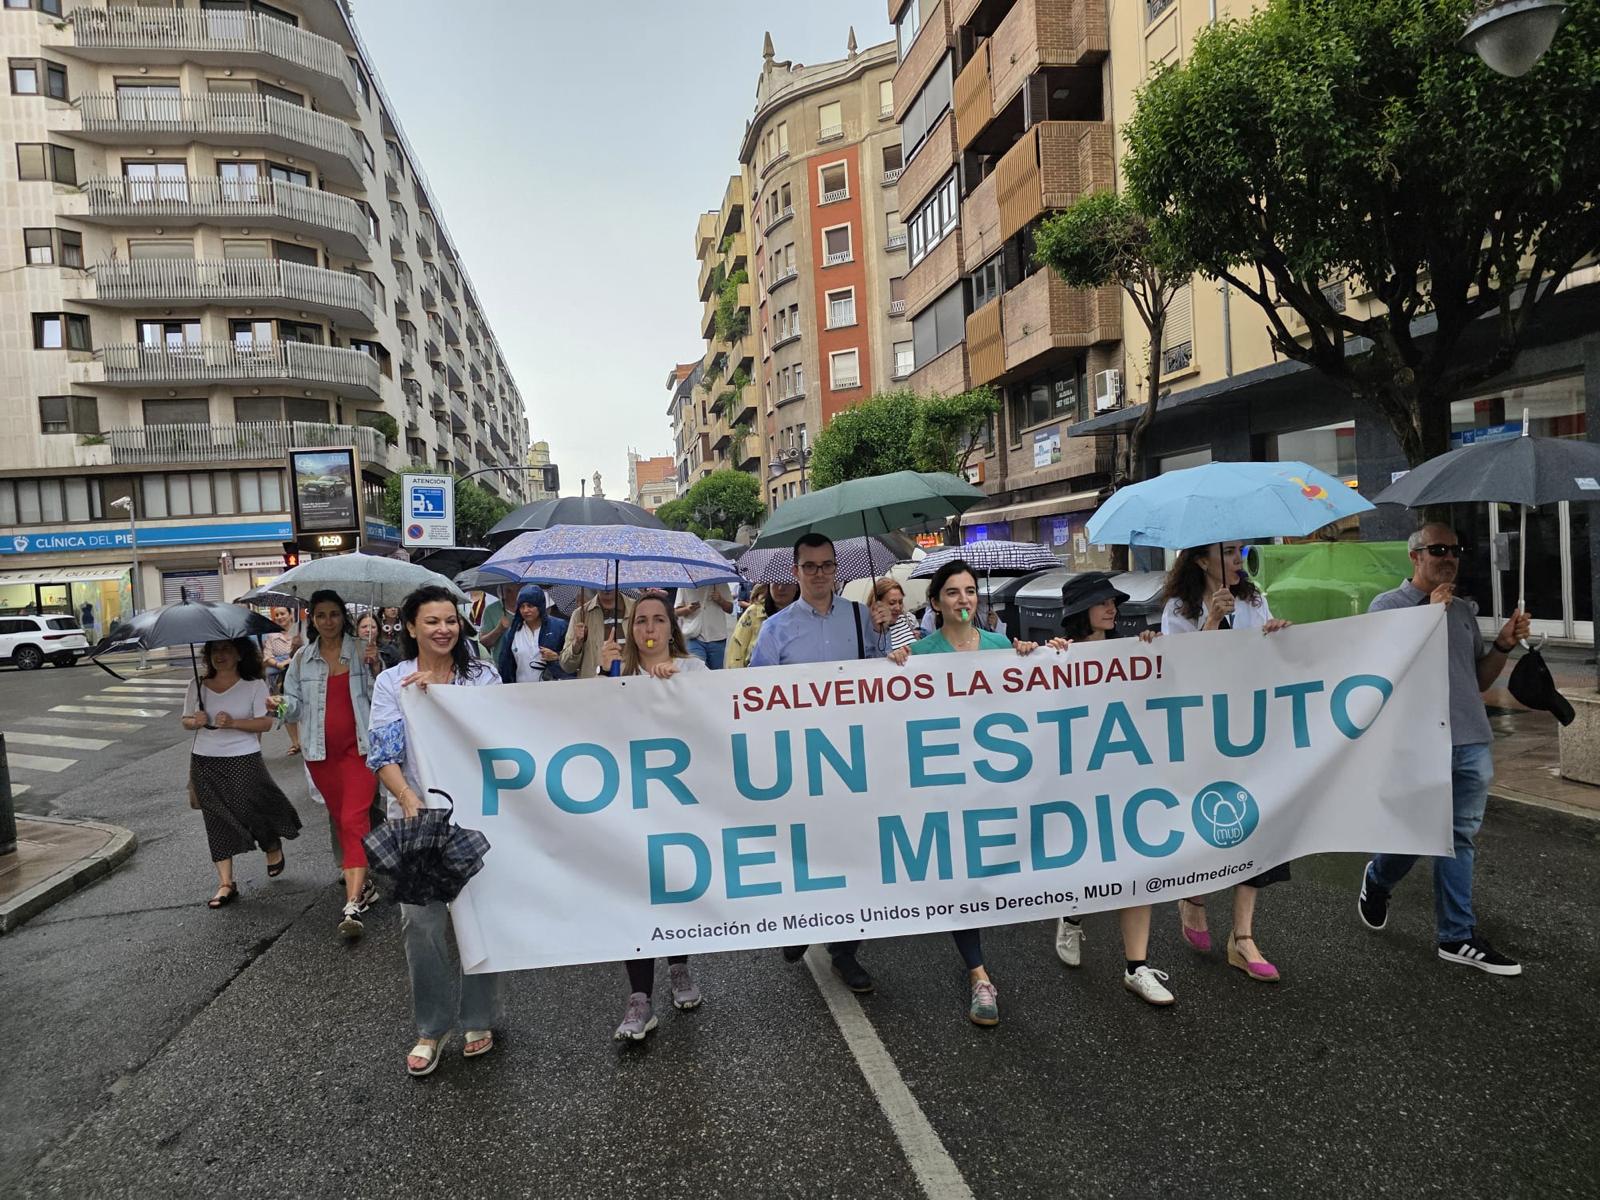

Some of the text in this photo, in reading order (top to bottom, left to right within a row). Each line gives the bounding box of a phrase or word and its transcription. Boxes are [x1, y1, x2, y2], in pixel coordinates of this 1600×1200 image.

[35, 534, 133, 548] CLÍNICA DEL PIE
[732, 654, 1163, 720] ¡SALVEMOS LA SANIDAD!
[479, 675, 1393, 816] POR UN ESTATUTO
[648, 823, 846, 905] DEL
[651, 922, 751, 941] Asociación
[756, 918, 778, 933] de
[782, 912, 855, 931] Médicos
[860, 906, 920, 923] Unidos
[925, 903, 955, 921] por
[960, 902, 990, 914] sus
[995, 891, 1079, 912] Derechos,
[1084, 882, 1124, 900] MUD
[1145, 859, 1254, 894] @mudmedicos
